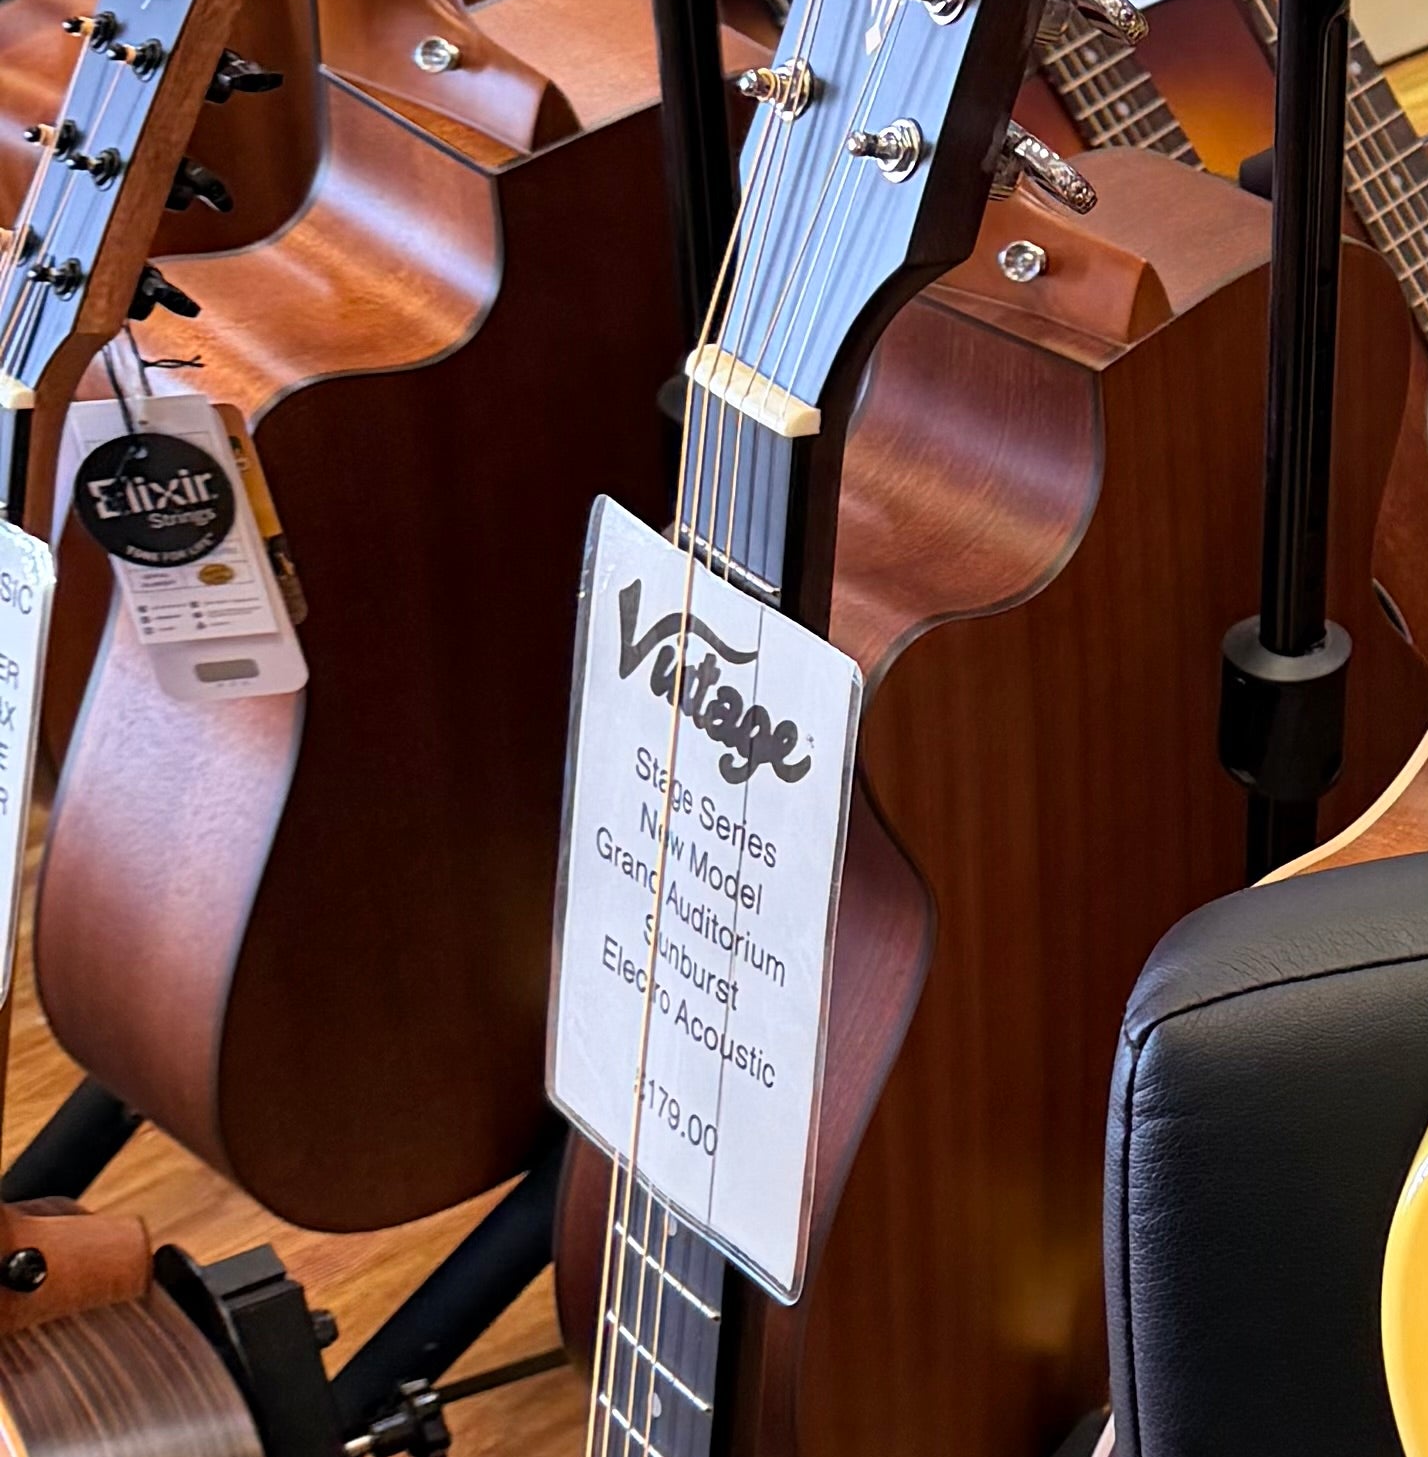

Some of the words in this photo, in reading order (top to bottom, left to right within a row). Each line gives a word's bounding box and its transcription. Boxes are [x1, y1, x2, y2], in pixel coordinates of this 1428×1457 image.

[87, 468, 215, 520] Elixir
[149, 508, 217, 530] Strings
[618, 578, 812, 785] Vintage
[635, 747, 693, 816] Stage
[700, 795, 778, 870] Series
[690, 841, 763, 915] Model
[644, 913, 739, 1011] Sunburst
[666, 881, 786, 988] Auditorium
[602, 934, 672, 1016] Elecro
[675, 999, 777, 1090] Acoustic
